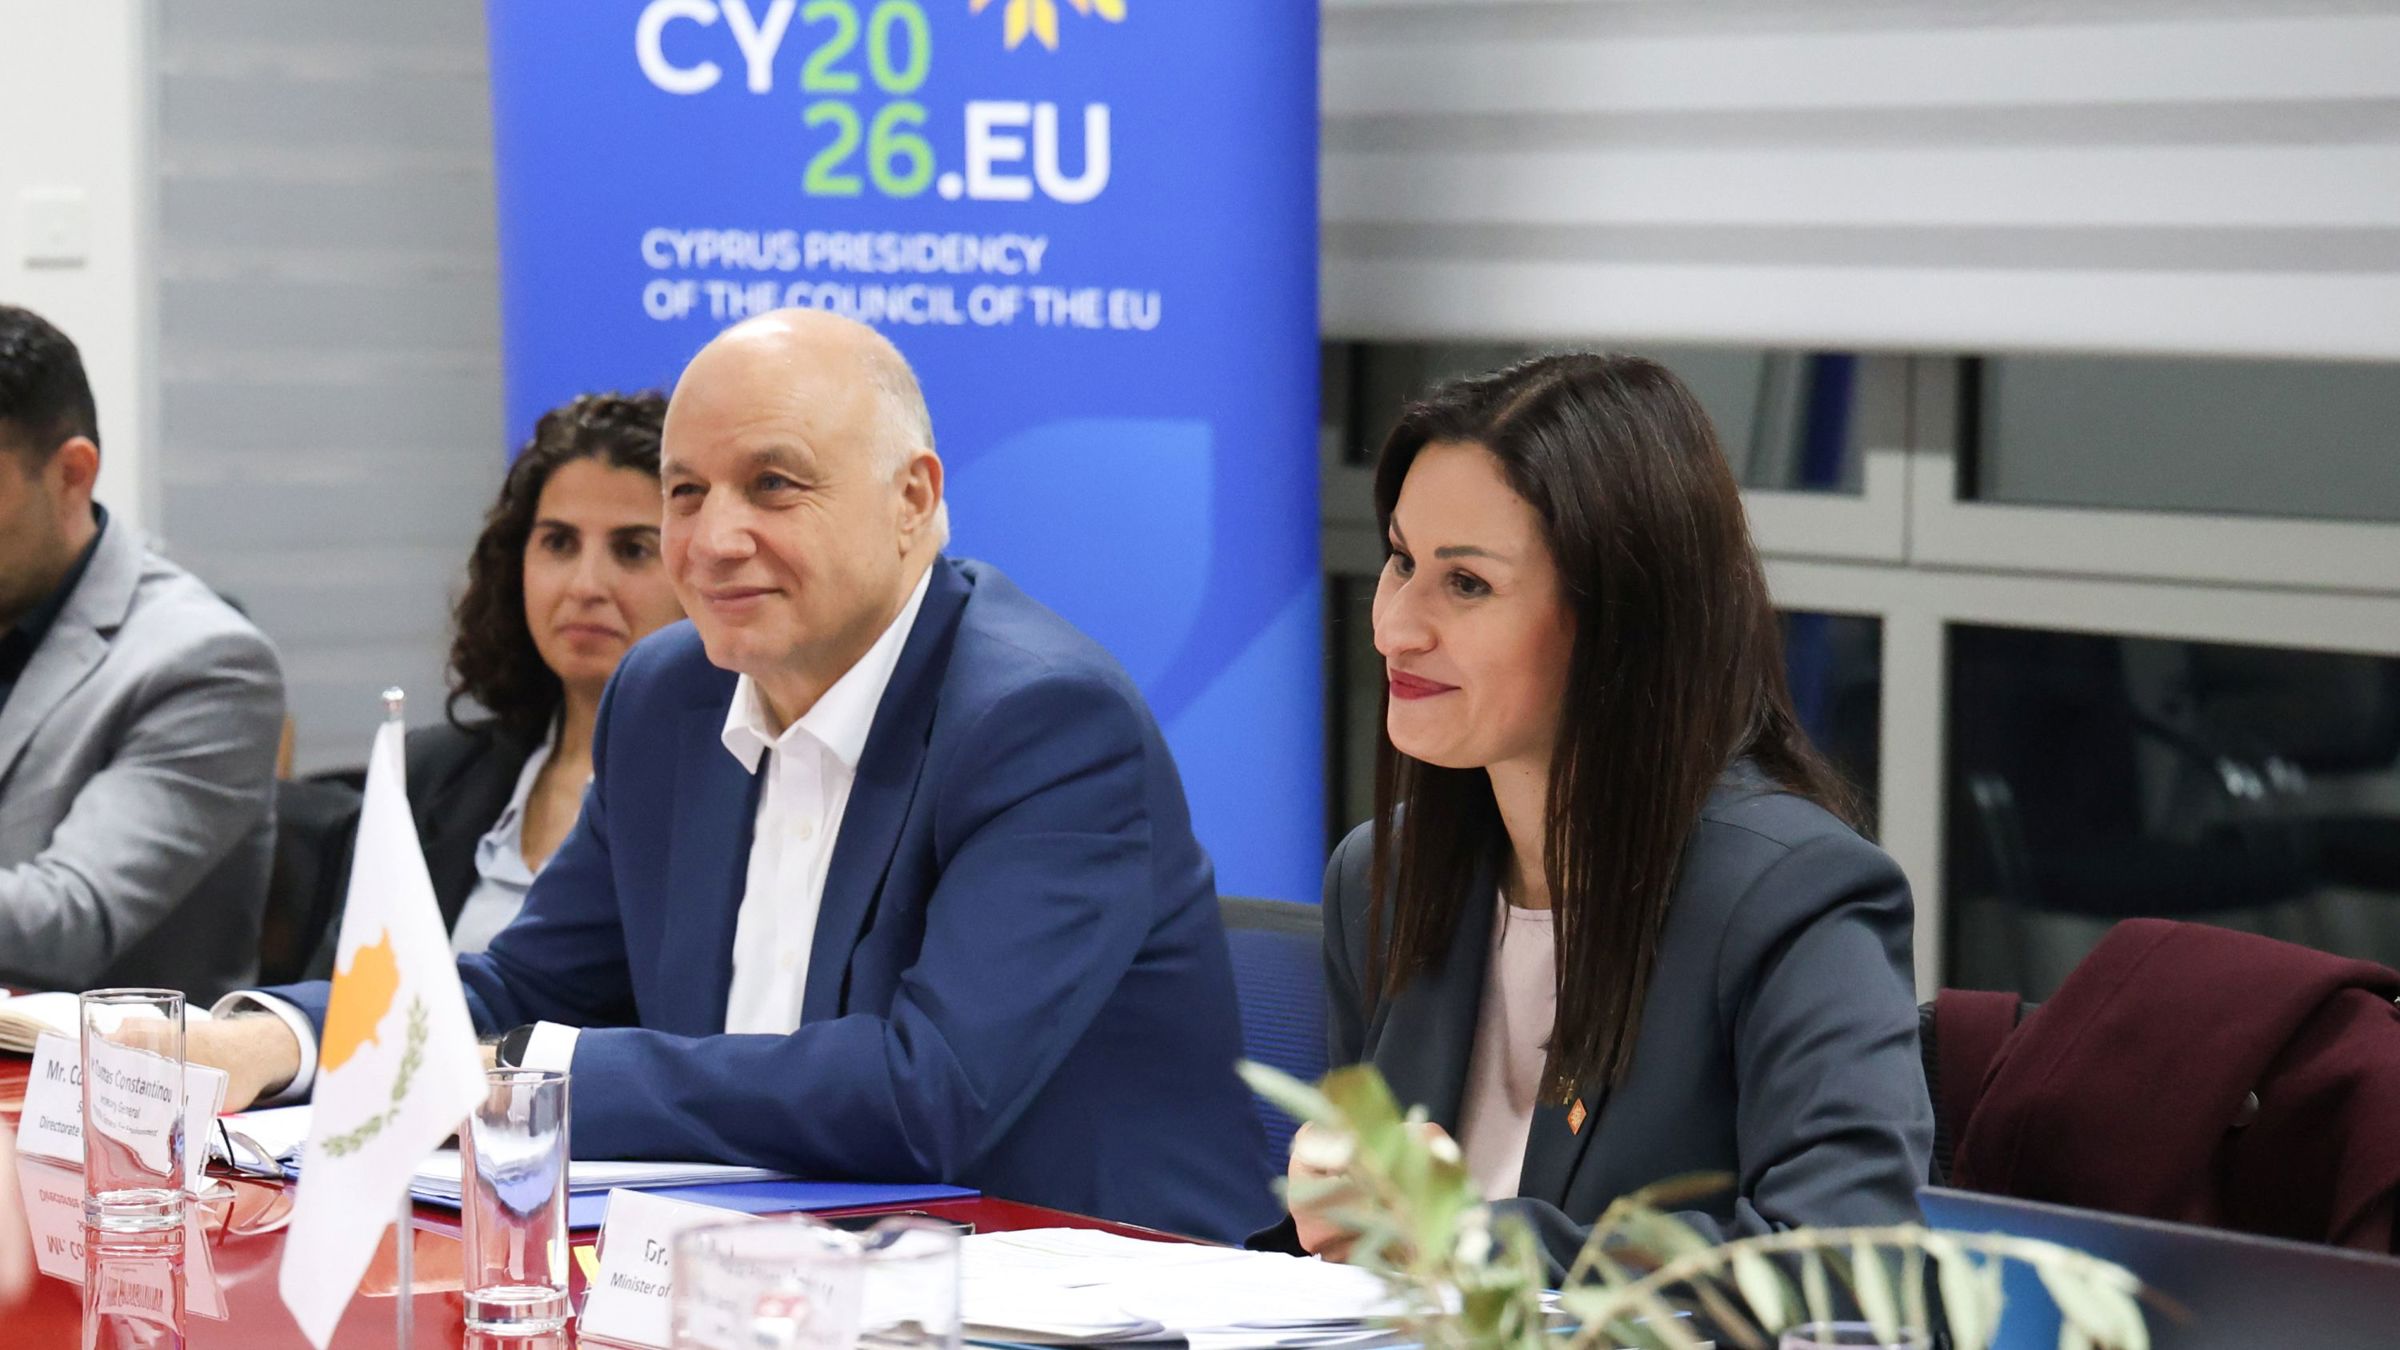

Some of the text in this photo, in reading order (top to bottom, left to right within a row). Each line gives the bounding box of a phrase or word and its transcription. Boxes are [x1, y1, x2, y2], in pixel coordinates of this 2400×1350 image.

[802, 100, 1112, 204] 26.EU
[641, 227, 1048, 275] CYPRUS PRESIDENCY
[642, 278, 1161, 331] OF THE COUNCIL OF THE EU
[46, 1059, 67, 1083] Mr.
[114, 1069, 173, 1103] Constantinou
[39, 1114, 81, 1137] Directorate
[643, 1237, 669, 1267] Dr.
[609, 1271, 656, 1296] Minister
[657, 1281, 673, 1299] of
